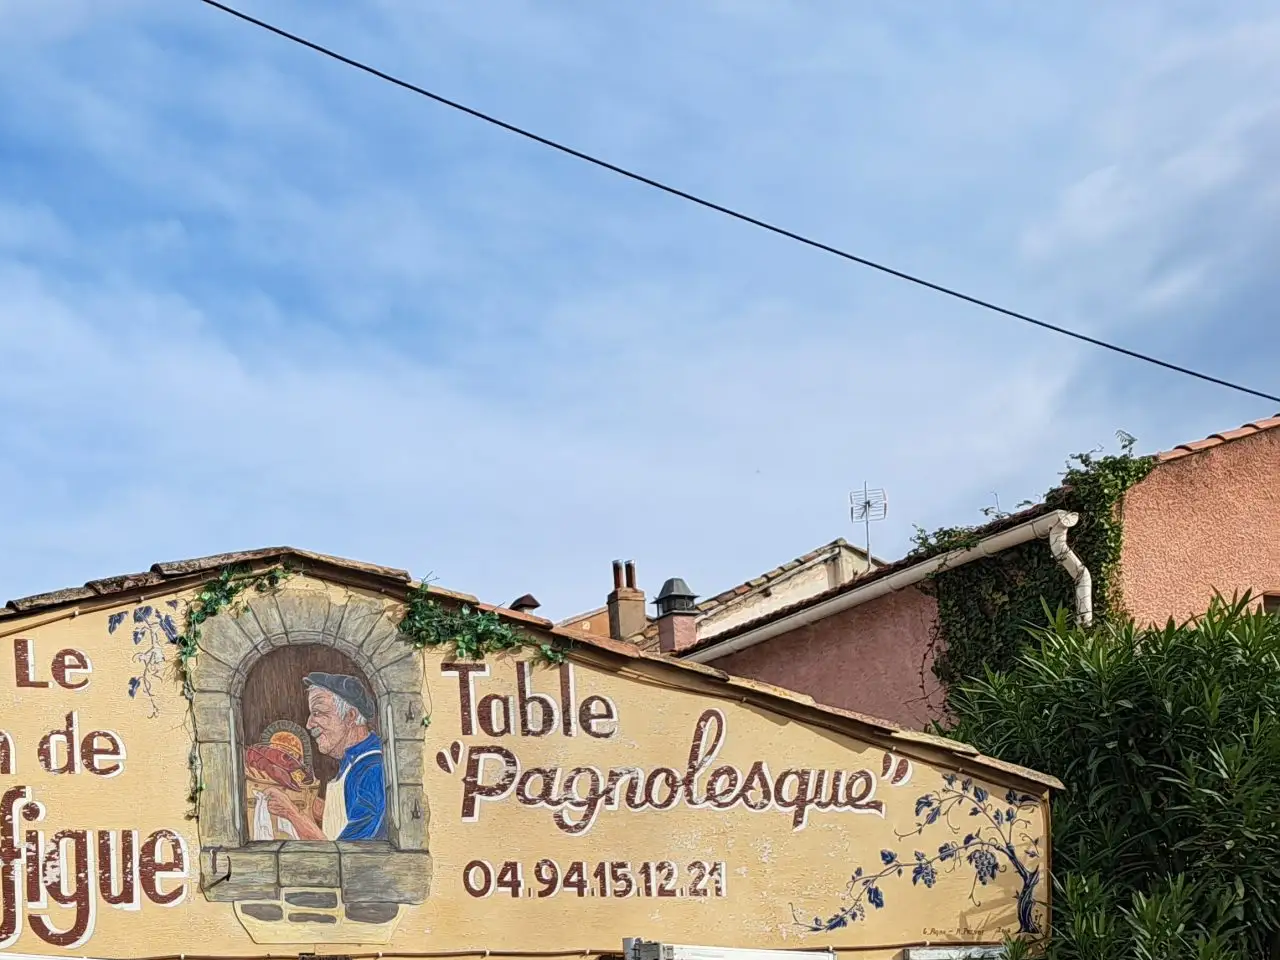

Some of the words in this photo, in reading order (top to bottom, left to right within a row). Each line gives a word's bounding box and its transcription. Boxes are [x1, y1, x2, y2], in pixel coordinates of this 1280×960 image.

[12, 637, 94, 691] Le
[440, 660, 618, 739] Table
[37, 710, 127, 778] de
[463, 859, 727, 898] 04.94.15.12.21
